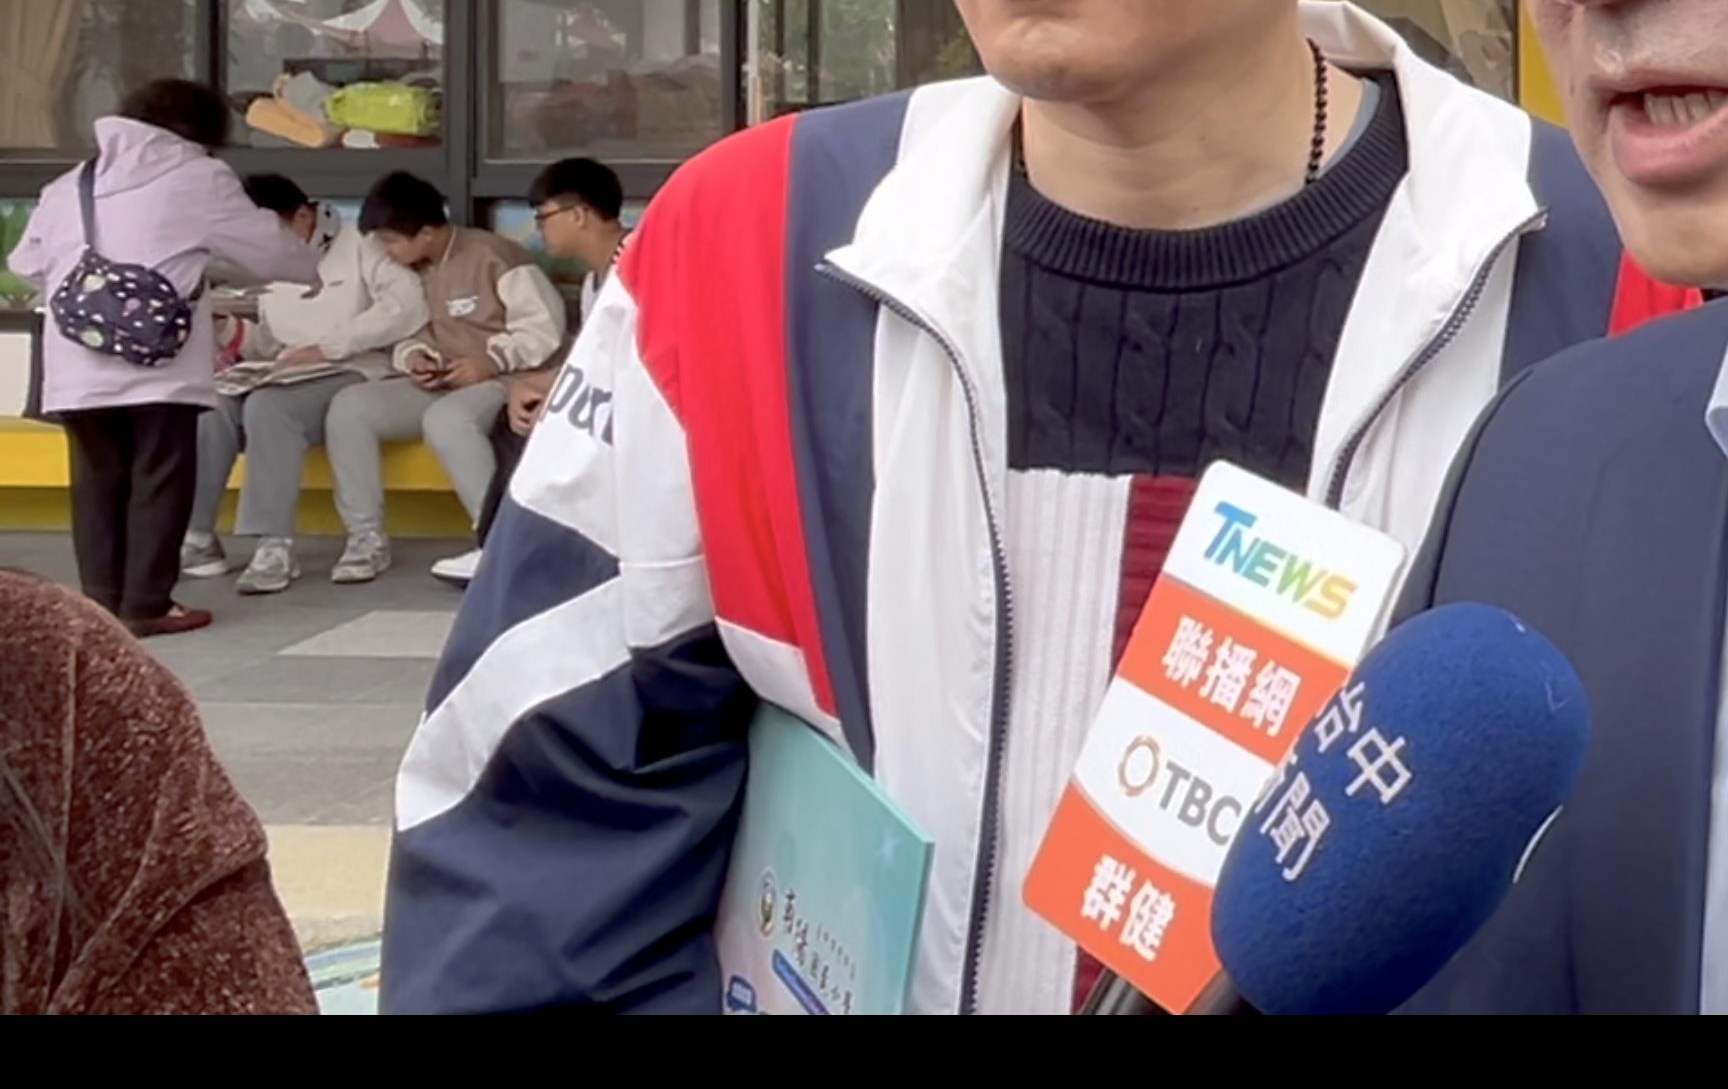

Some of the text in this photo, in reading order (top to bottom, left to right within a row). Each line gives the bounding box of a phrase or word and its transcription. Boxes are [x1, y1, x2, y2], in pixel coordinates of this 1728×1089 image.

[1203, 501, 1359, 621] TNEWS
[1160, 616, 1302, 737] 聯播網
[1159, 761, 1243, 846] TBC
[1079, 856, 1177, 962] 群健
